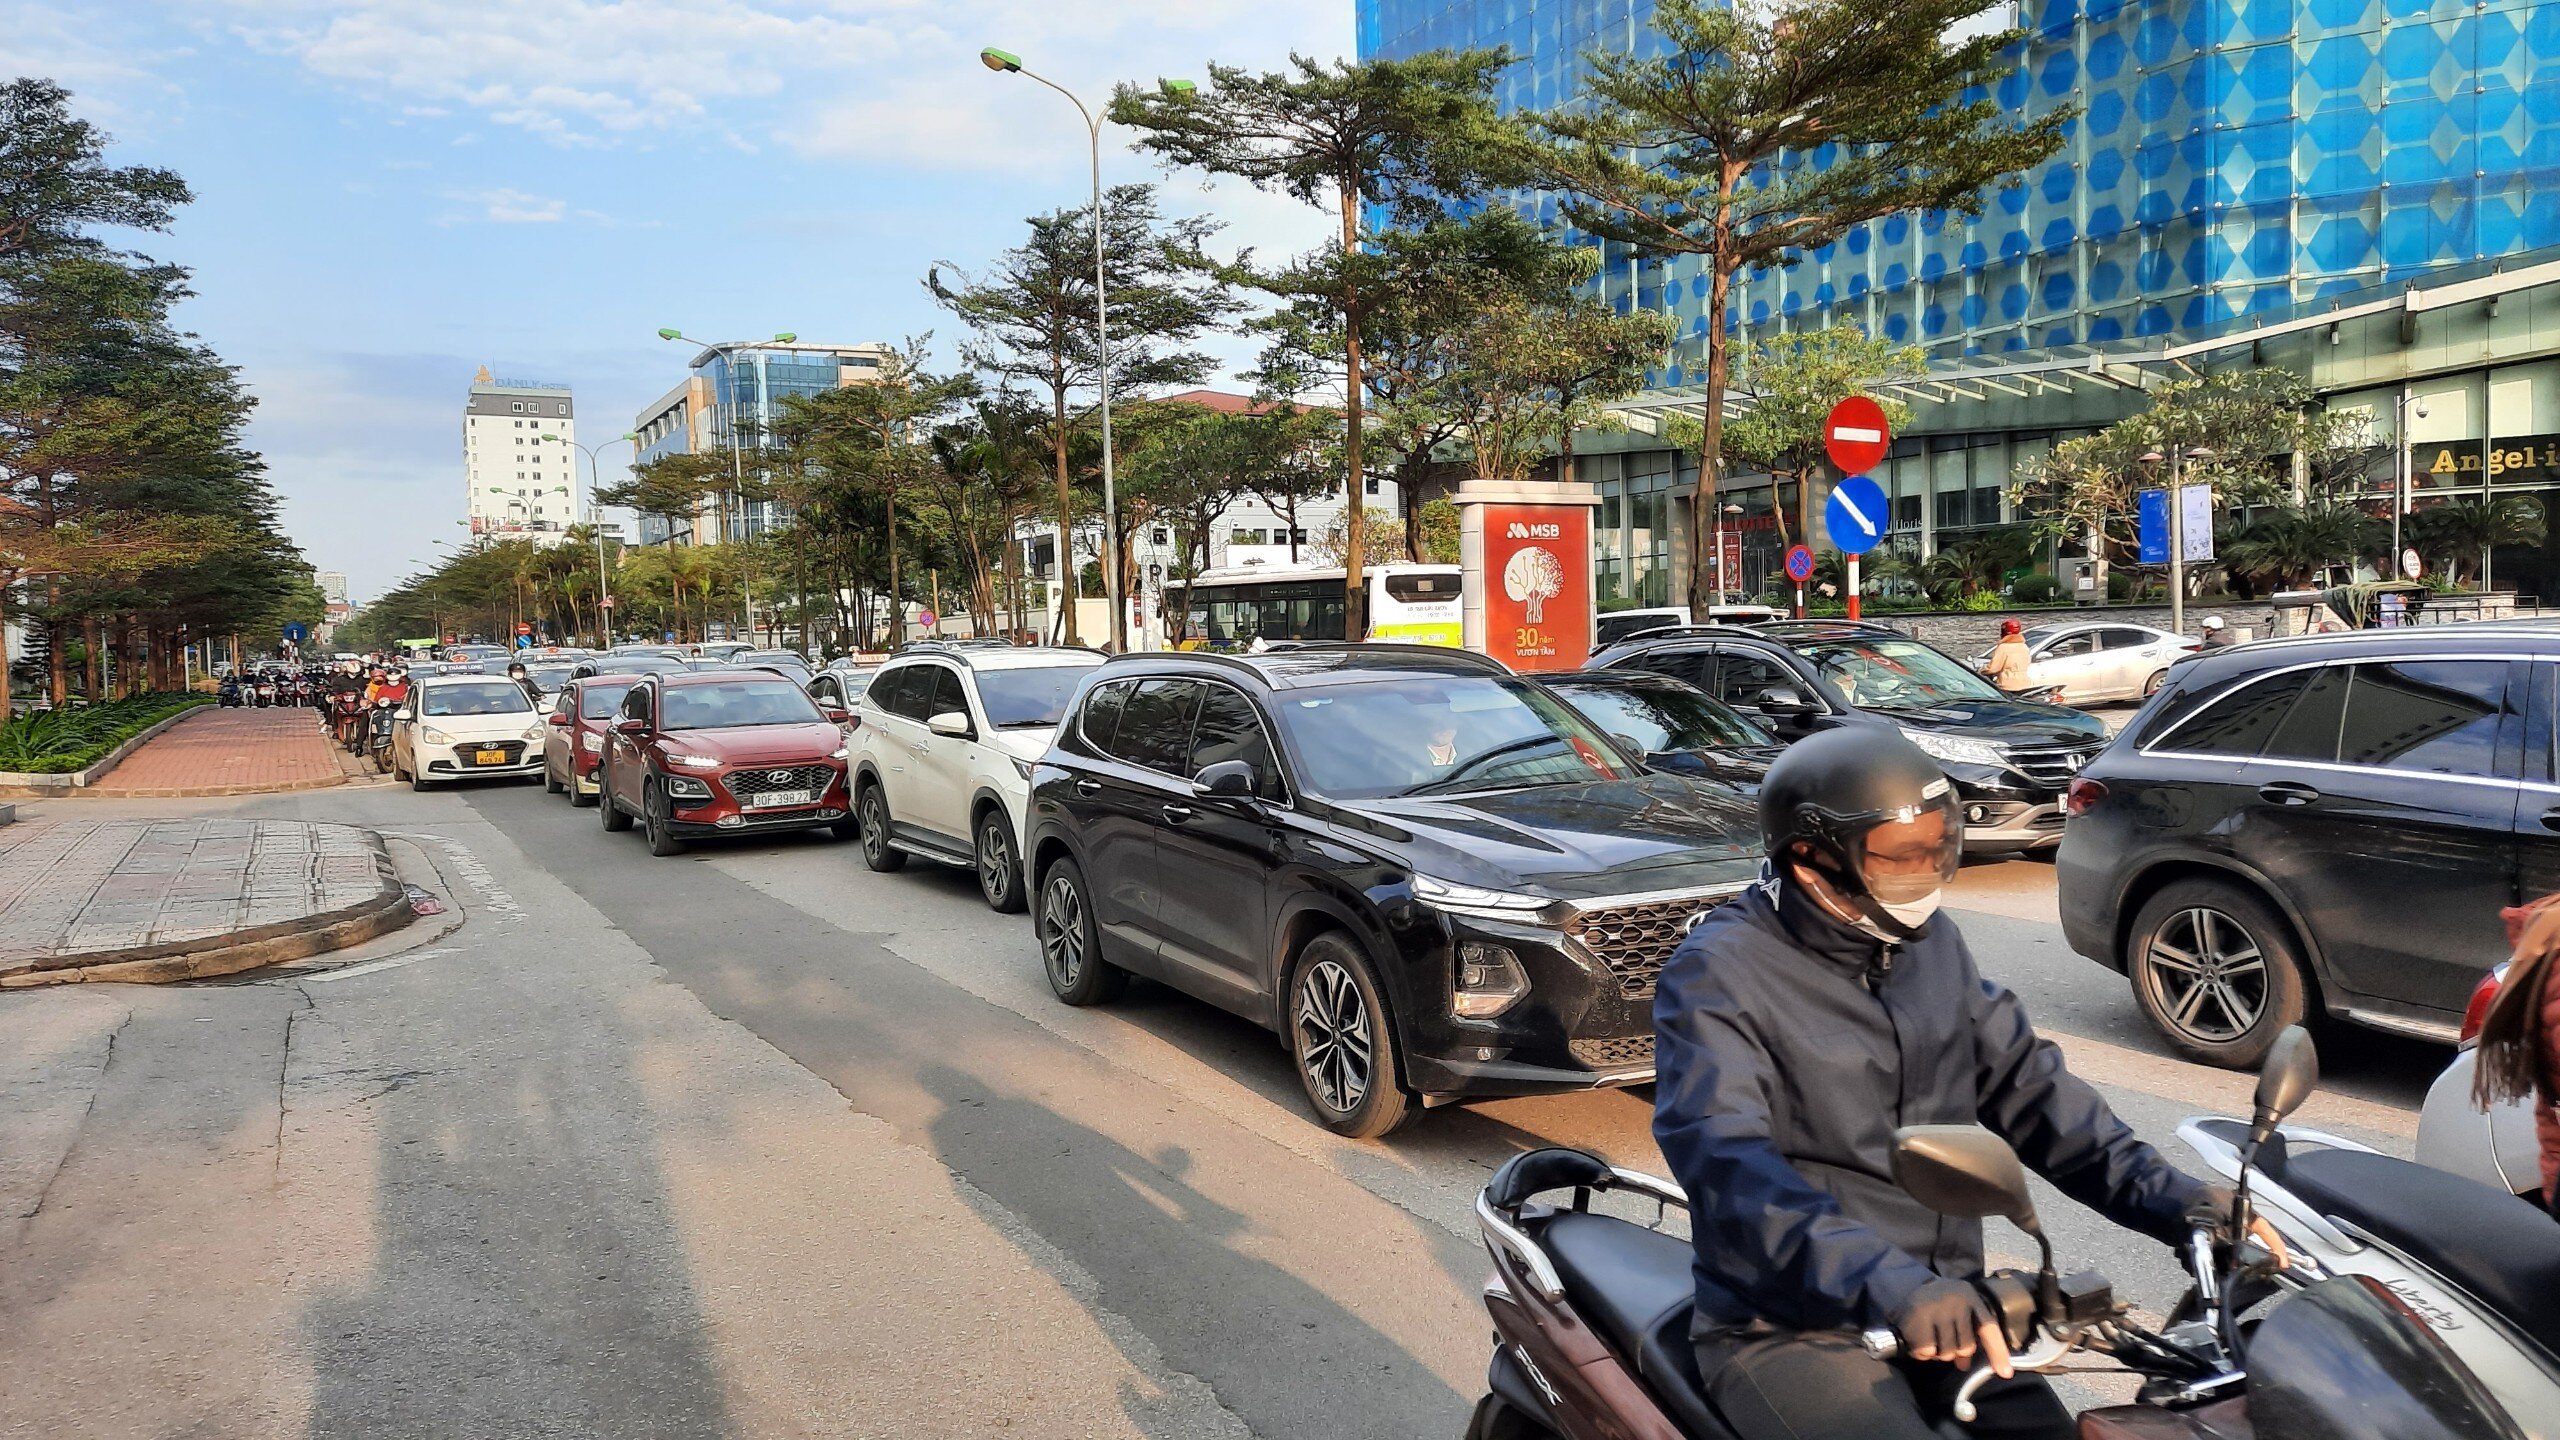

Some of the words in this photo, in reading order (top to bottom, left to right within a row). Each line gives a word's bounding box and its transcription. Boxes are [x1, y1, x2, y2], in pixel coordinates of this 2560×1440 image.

[1530, 523, 1560, 538] MSB
[1052, 588, 1061, 599] P
[1515, 627, 1539, 648] 30
[2382, 1279, 2464, 1331] Liberty
